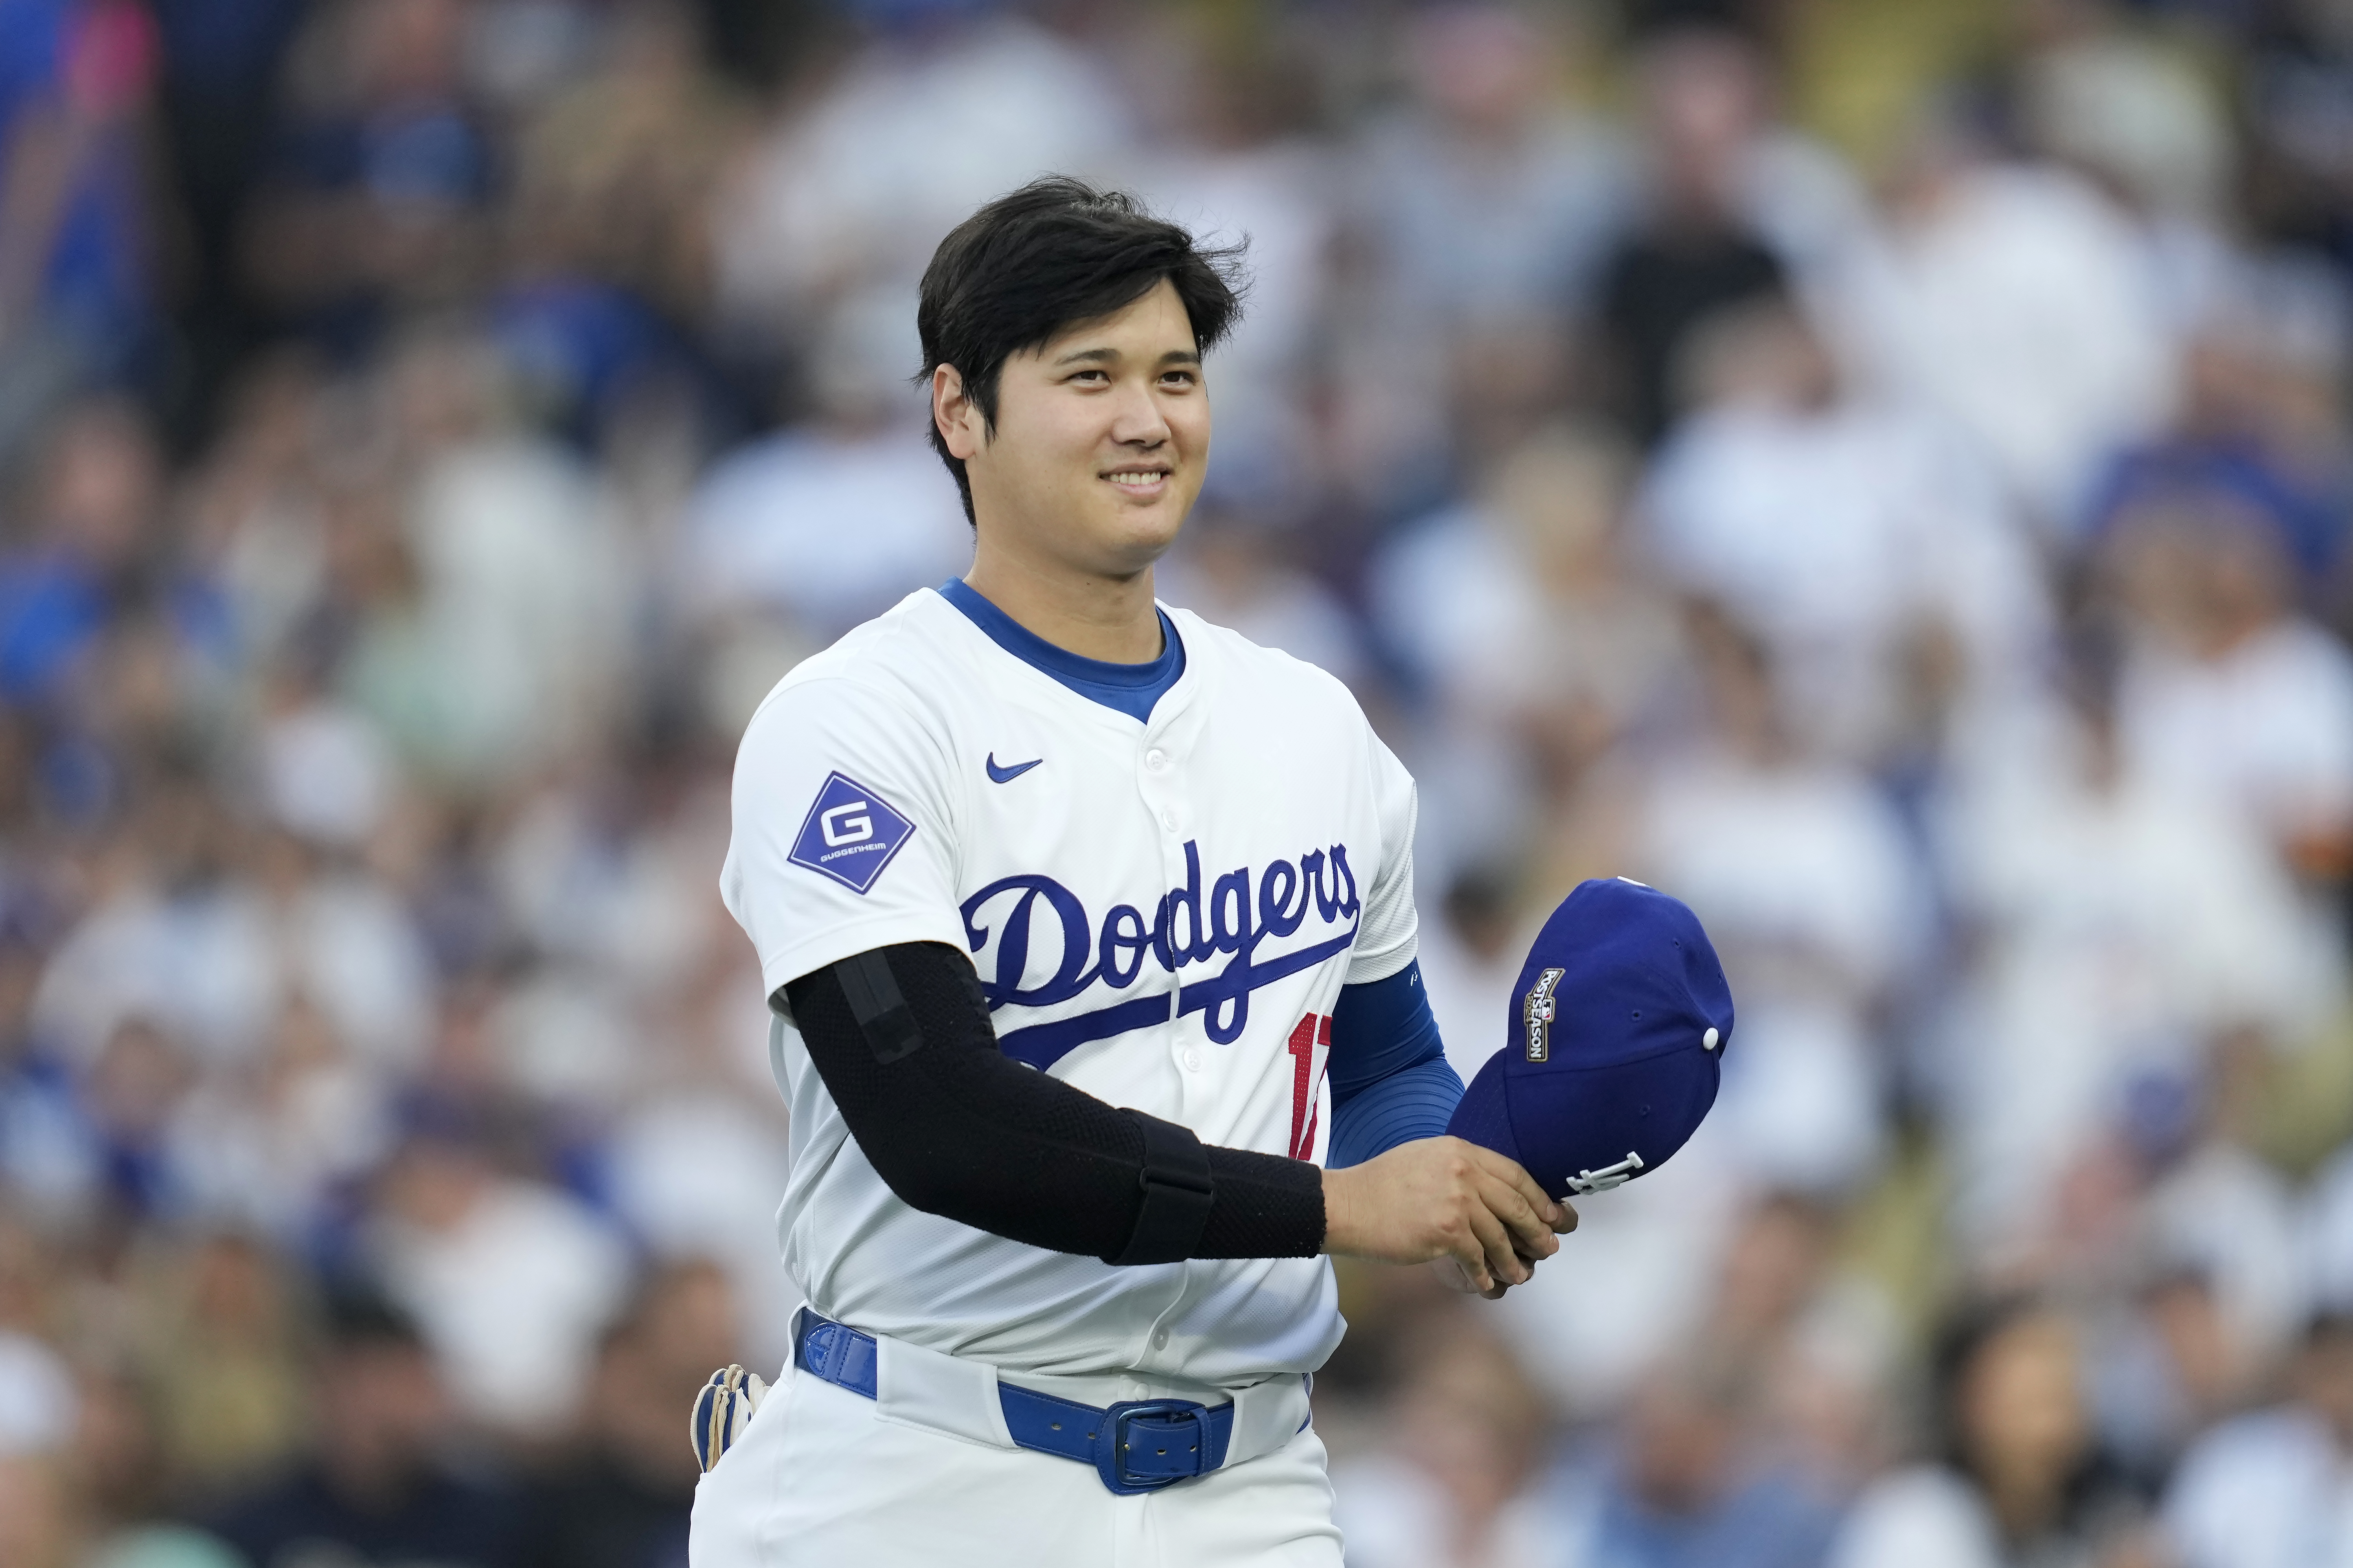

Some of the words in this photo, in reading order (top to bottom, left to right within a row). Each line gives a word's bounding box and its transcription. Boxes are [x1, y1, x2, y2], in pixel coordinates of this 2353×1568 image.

[820, 801, 873, 847] G
[820, 842, 886, 863] GUGGENHEIM
[959, 839, 1360, 1045] Dodgers
[1531, 970, 1558, 1059] POSTSEASON
